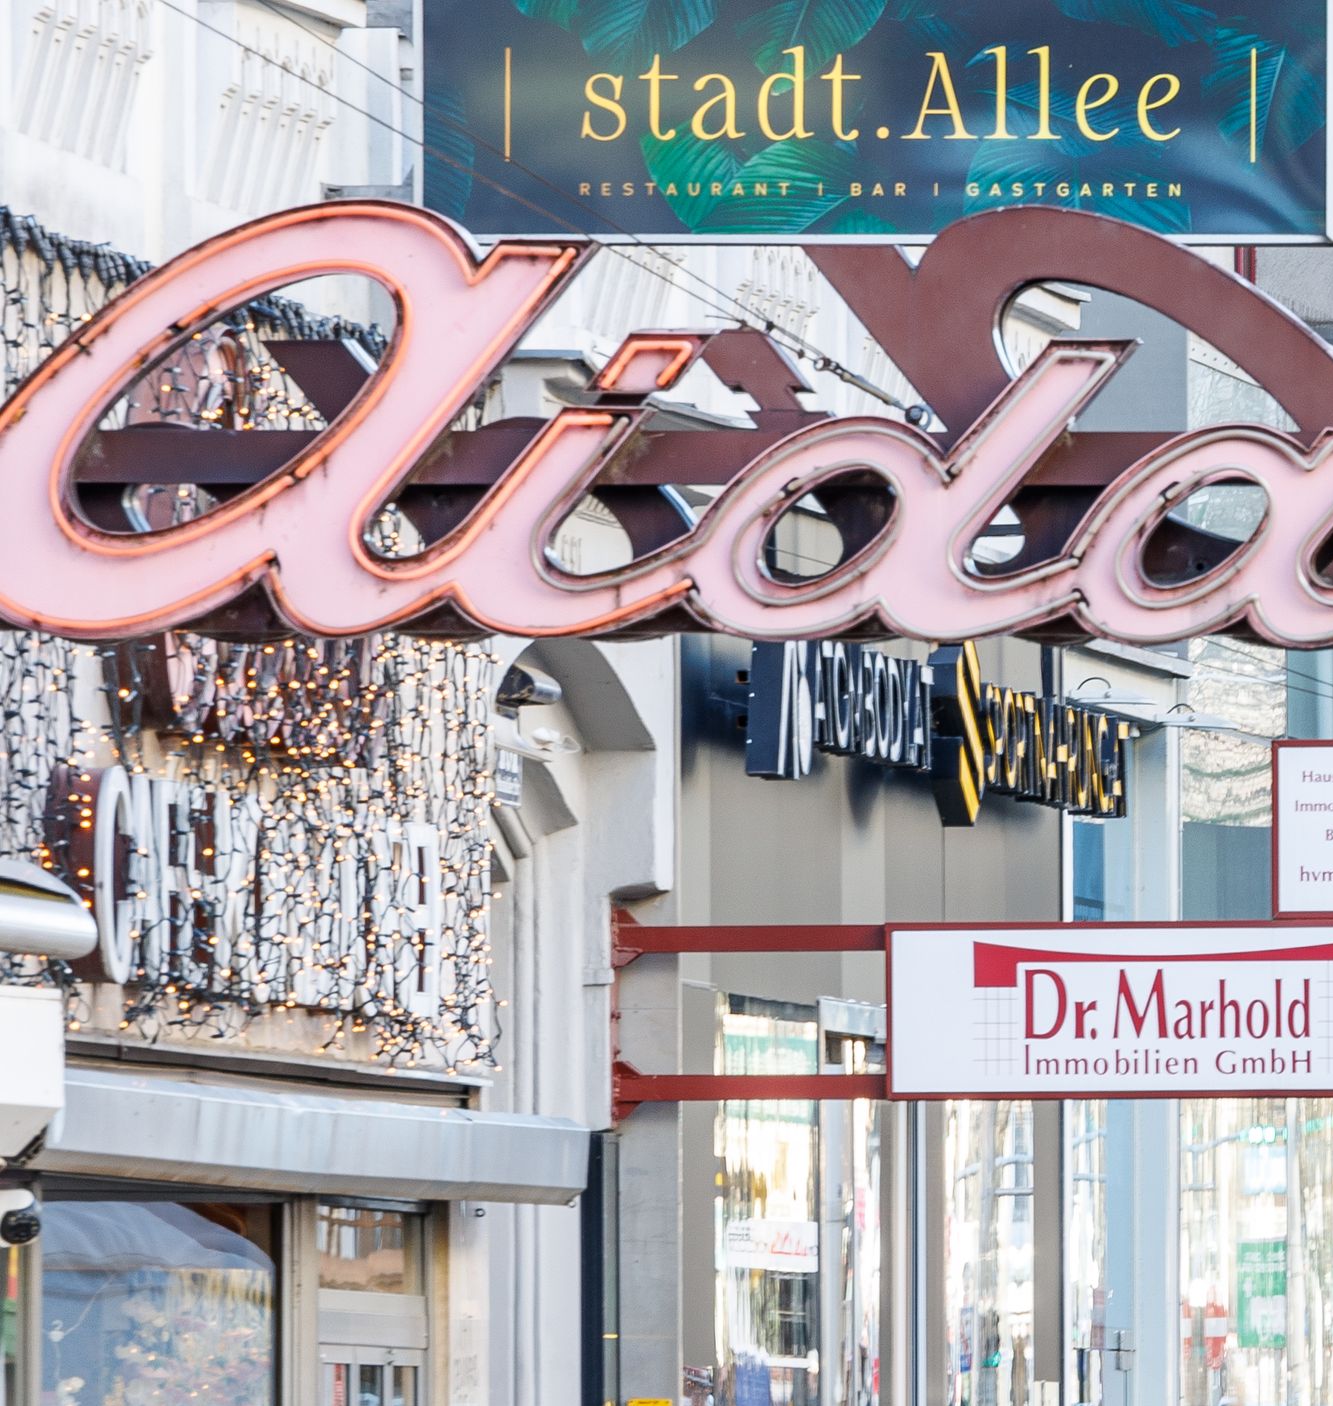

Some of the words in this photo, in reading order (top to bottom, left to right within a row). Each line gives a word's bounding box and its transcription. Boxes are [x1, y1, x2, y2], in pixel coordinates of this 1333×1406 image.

[580, 45, 1183, 143] stadt.Allee
[580, 182, 791, 197] RESTAURANT
[851, 182, 909, 197] BAR
[966, 182, 1184, 197] GASTGARTEN
[1024, 968, 1098, 1041] Dr.
[1112, 968, 1311, 1041] Marhold
[1024, 1044, 1199, 1076] Immobilien
[1214, 1047, 1313, 1075] GmbH
